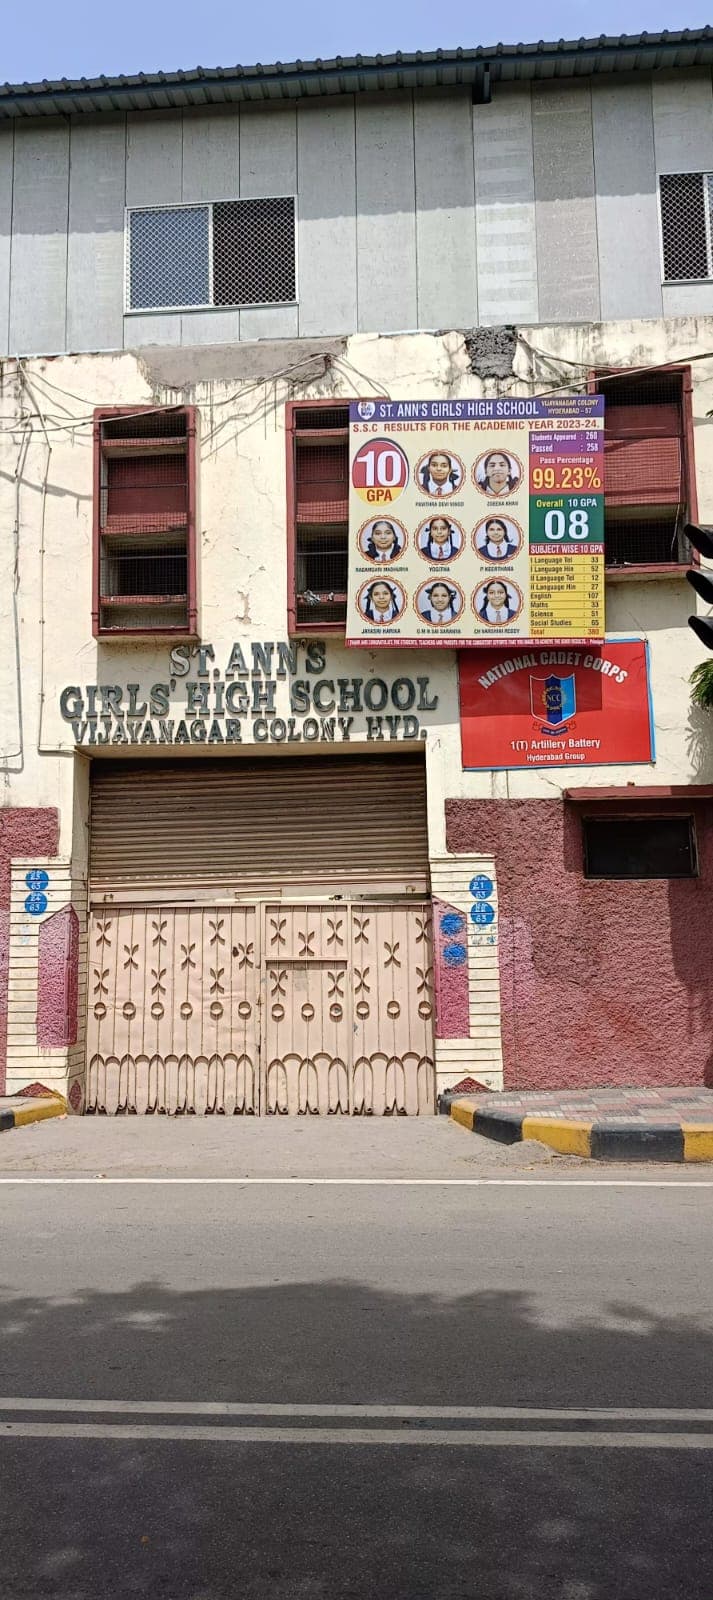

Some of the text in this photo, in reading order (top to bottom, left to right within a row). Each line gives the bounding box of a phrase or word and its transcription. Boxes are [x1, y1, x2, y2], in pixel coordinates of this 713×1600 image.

[380, 404, 395, 417] ST.
[397, 403, 428, 417] ANN'S
[431, 402, 465, 416] GIRLS'
[467, 402, 493, 416] HIGH
[496, 401, 540, 415] SCHOOL
[547, 407, 580, 415] HYDERABAD
[353, 419, 600, 432] S.S.C RESULTS FOR THE ACADEMIC YEAR 2023-24.
[531, 434, 552, 442] Students
[553, 433, 577, 442] Appeared
[585, 431, 598, 440] 260
[531, 444, 553, 452] Passed
[586, 443, 599, 451] 258
[556, 456, 594, 465] Percentage
[356, 451, 402, 487] 10
[532, 466, 601, 489] 99.23%
[366, 489, 393, 502] GPA
[536, 498, 597, 508] Overall 10 GPA
[544, 509, 589, 540] 08
[530, 544, 603, 553] SUBJECT WISE 10 GPA
[534, 557, 562, 565] Language
[530, 593, 552, 601] English
[169, 640, 326, 680] ST. ANN'S
[477, 652, 629, 689] NATIONAL CADET CORPS
[60, 677, 438, 719] GIRLS' HIGH SCHOOL
[72, 715, 427, 744] VIJAYANAGAR COLONY HYD.
[511, 738, 601, 751] 1(T) Artillery Battery
[526, 752, 586, 762] Hyderabad Group
